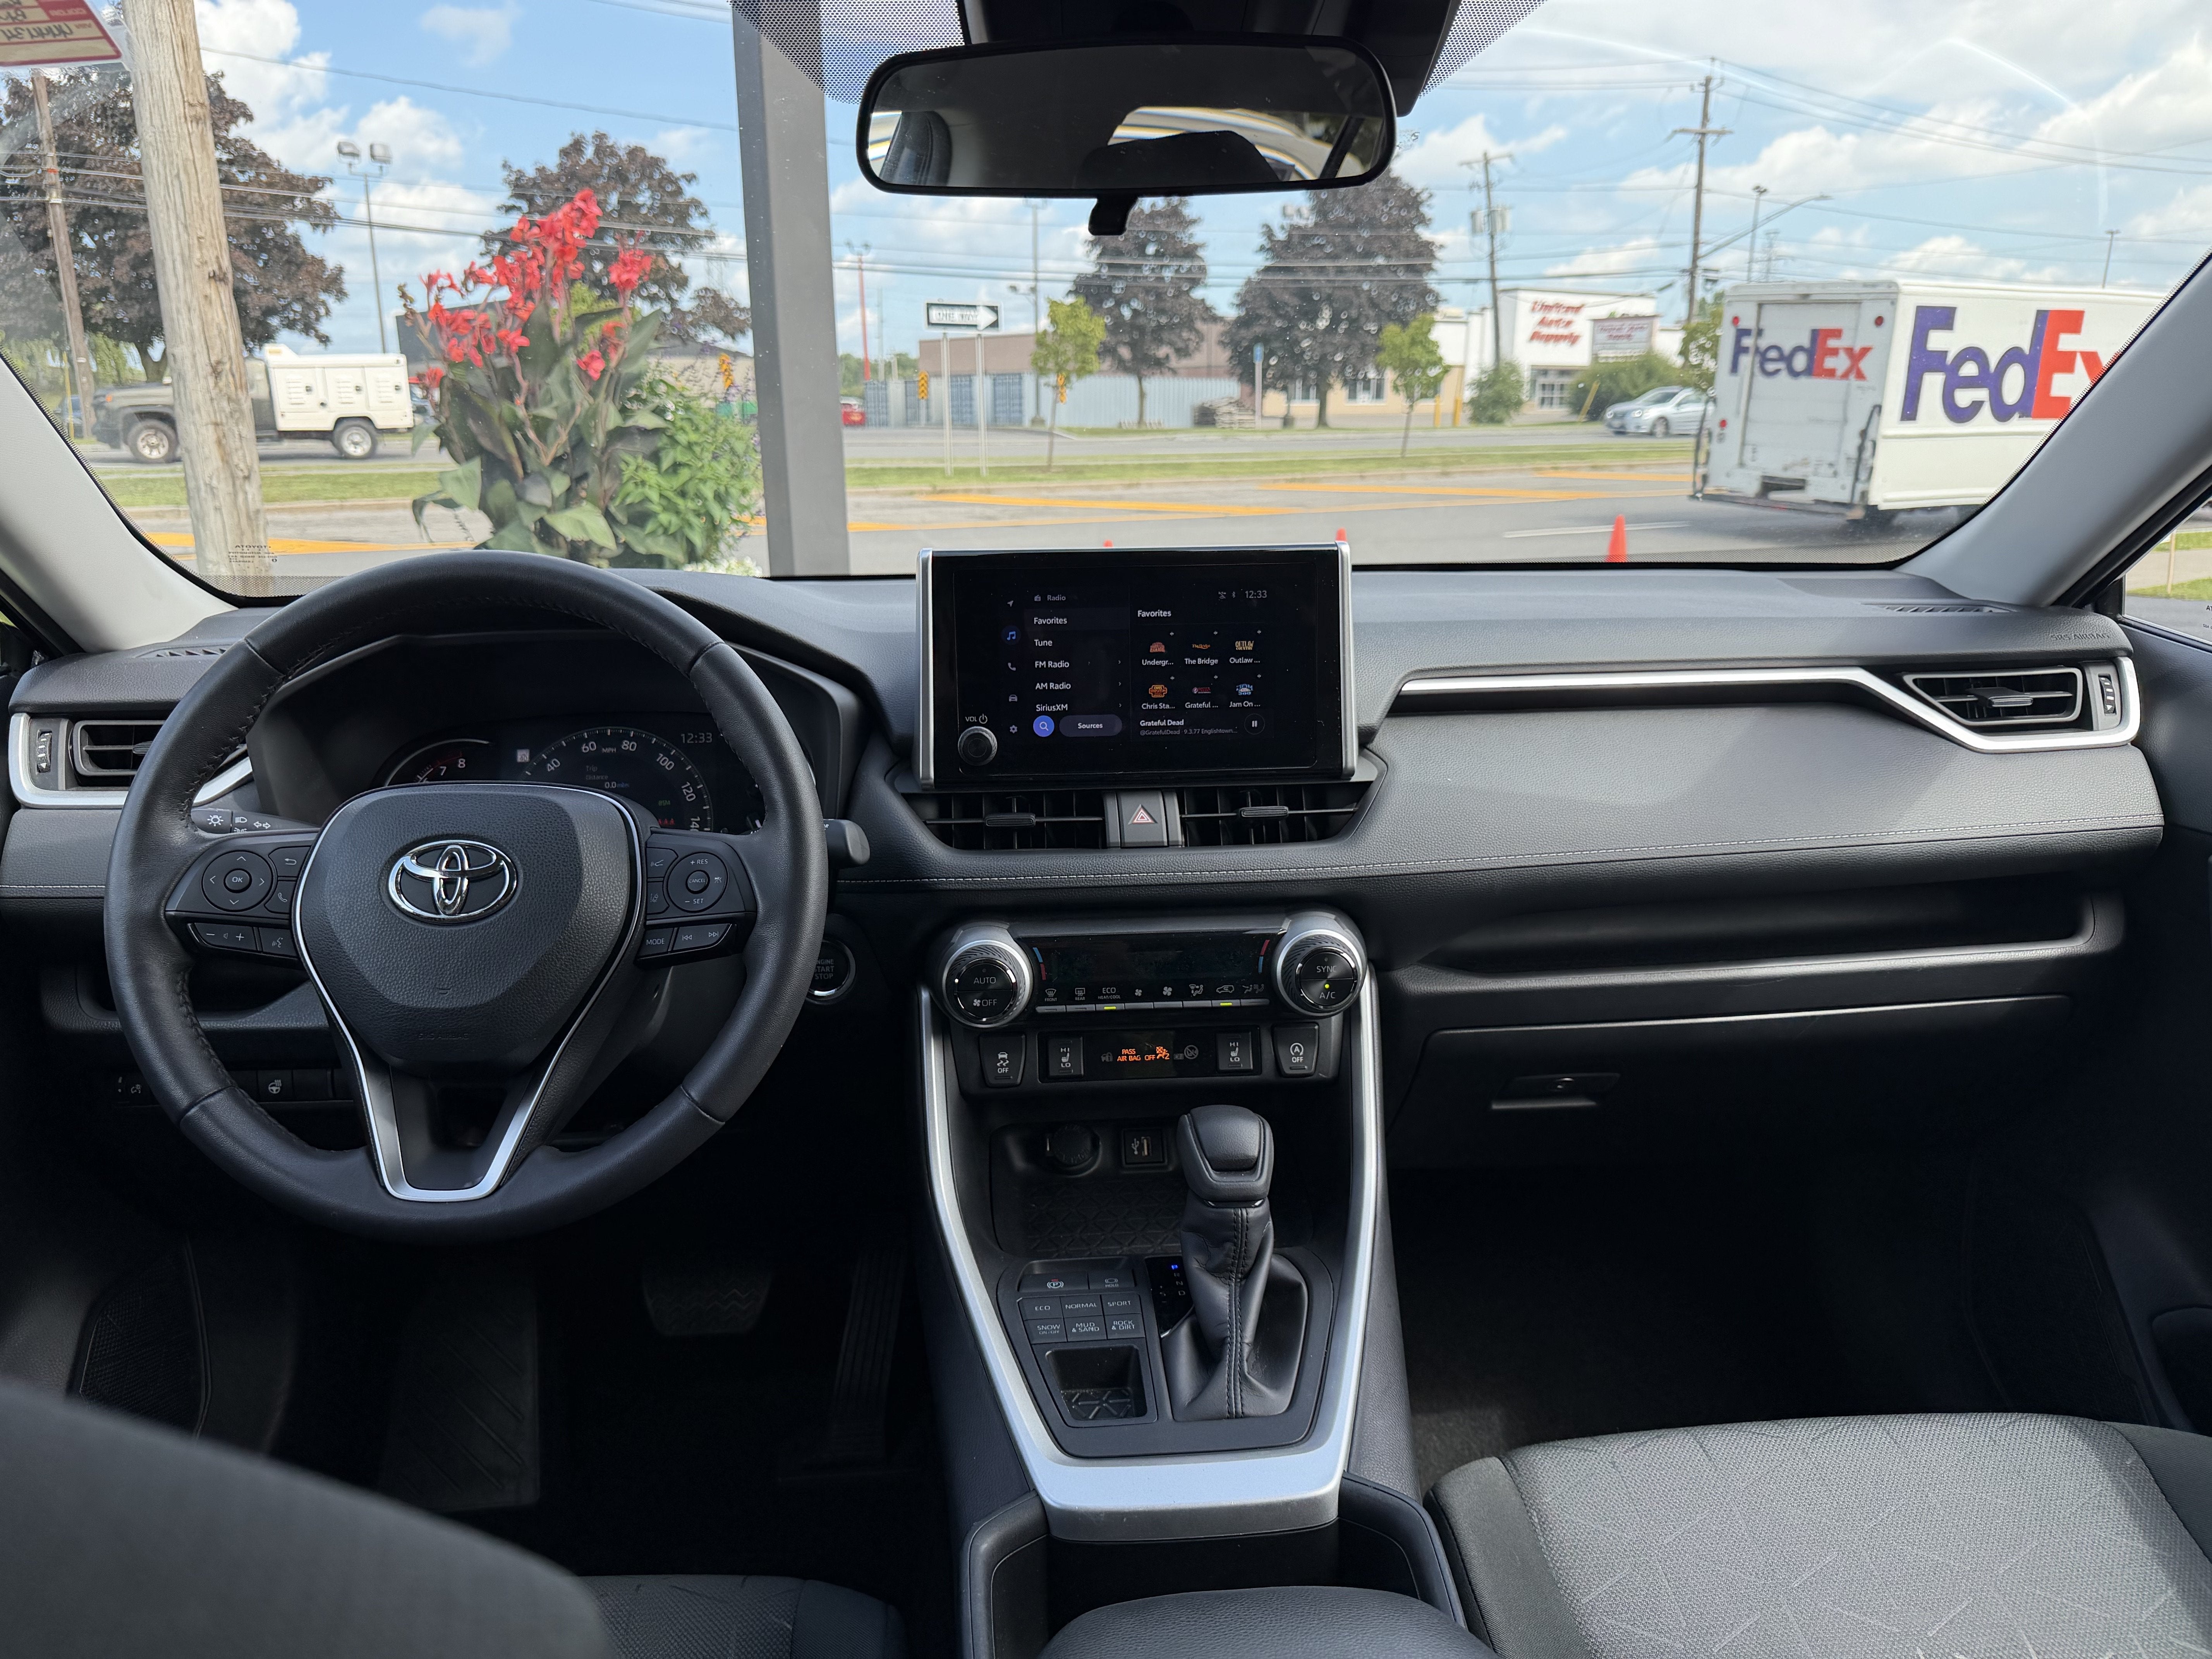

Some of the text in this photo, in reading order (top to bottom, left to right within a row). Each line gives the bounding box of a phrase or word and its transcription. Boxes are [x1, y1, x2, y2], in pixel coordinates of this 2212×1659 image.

[1730, 328, 1873, 381] FedEx
[681, 733, 713, 744] 12:33
[581, 741, 597, 753] 60
[621, 740, 637, 752] 80
[458, 758, 466, 768] 8
[547, 758, 560, 772] 40
[656, 753, 675, 771] 100
[440, 766, 447, 776] 7
[681, 781, 696, 802] 120
[690, 816, 701, 831] 14
